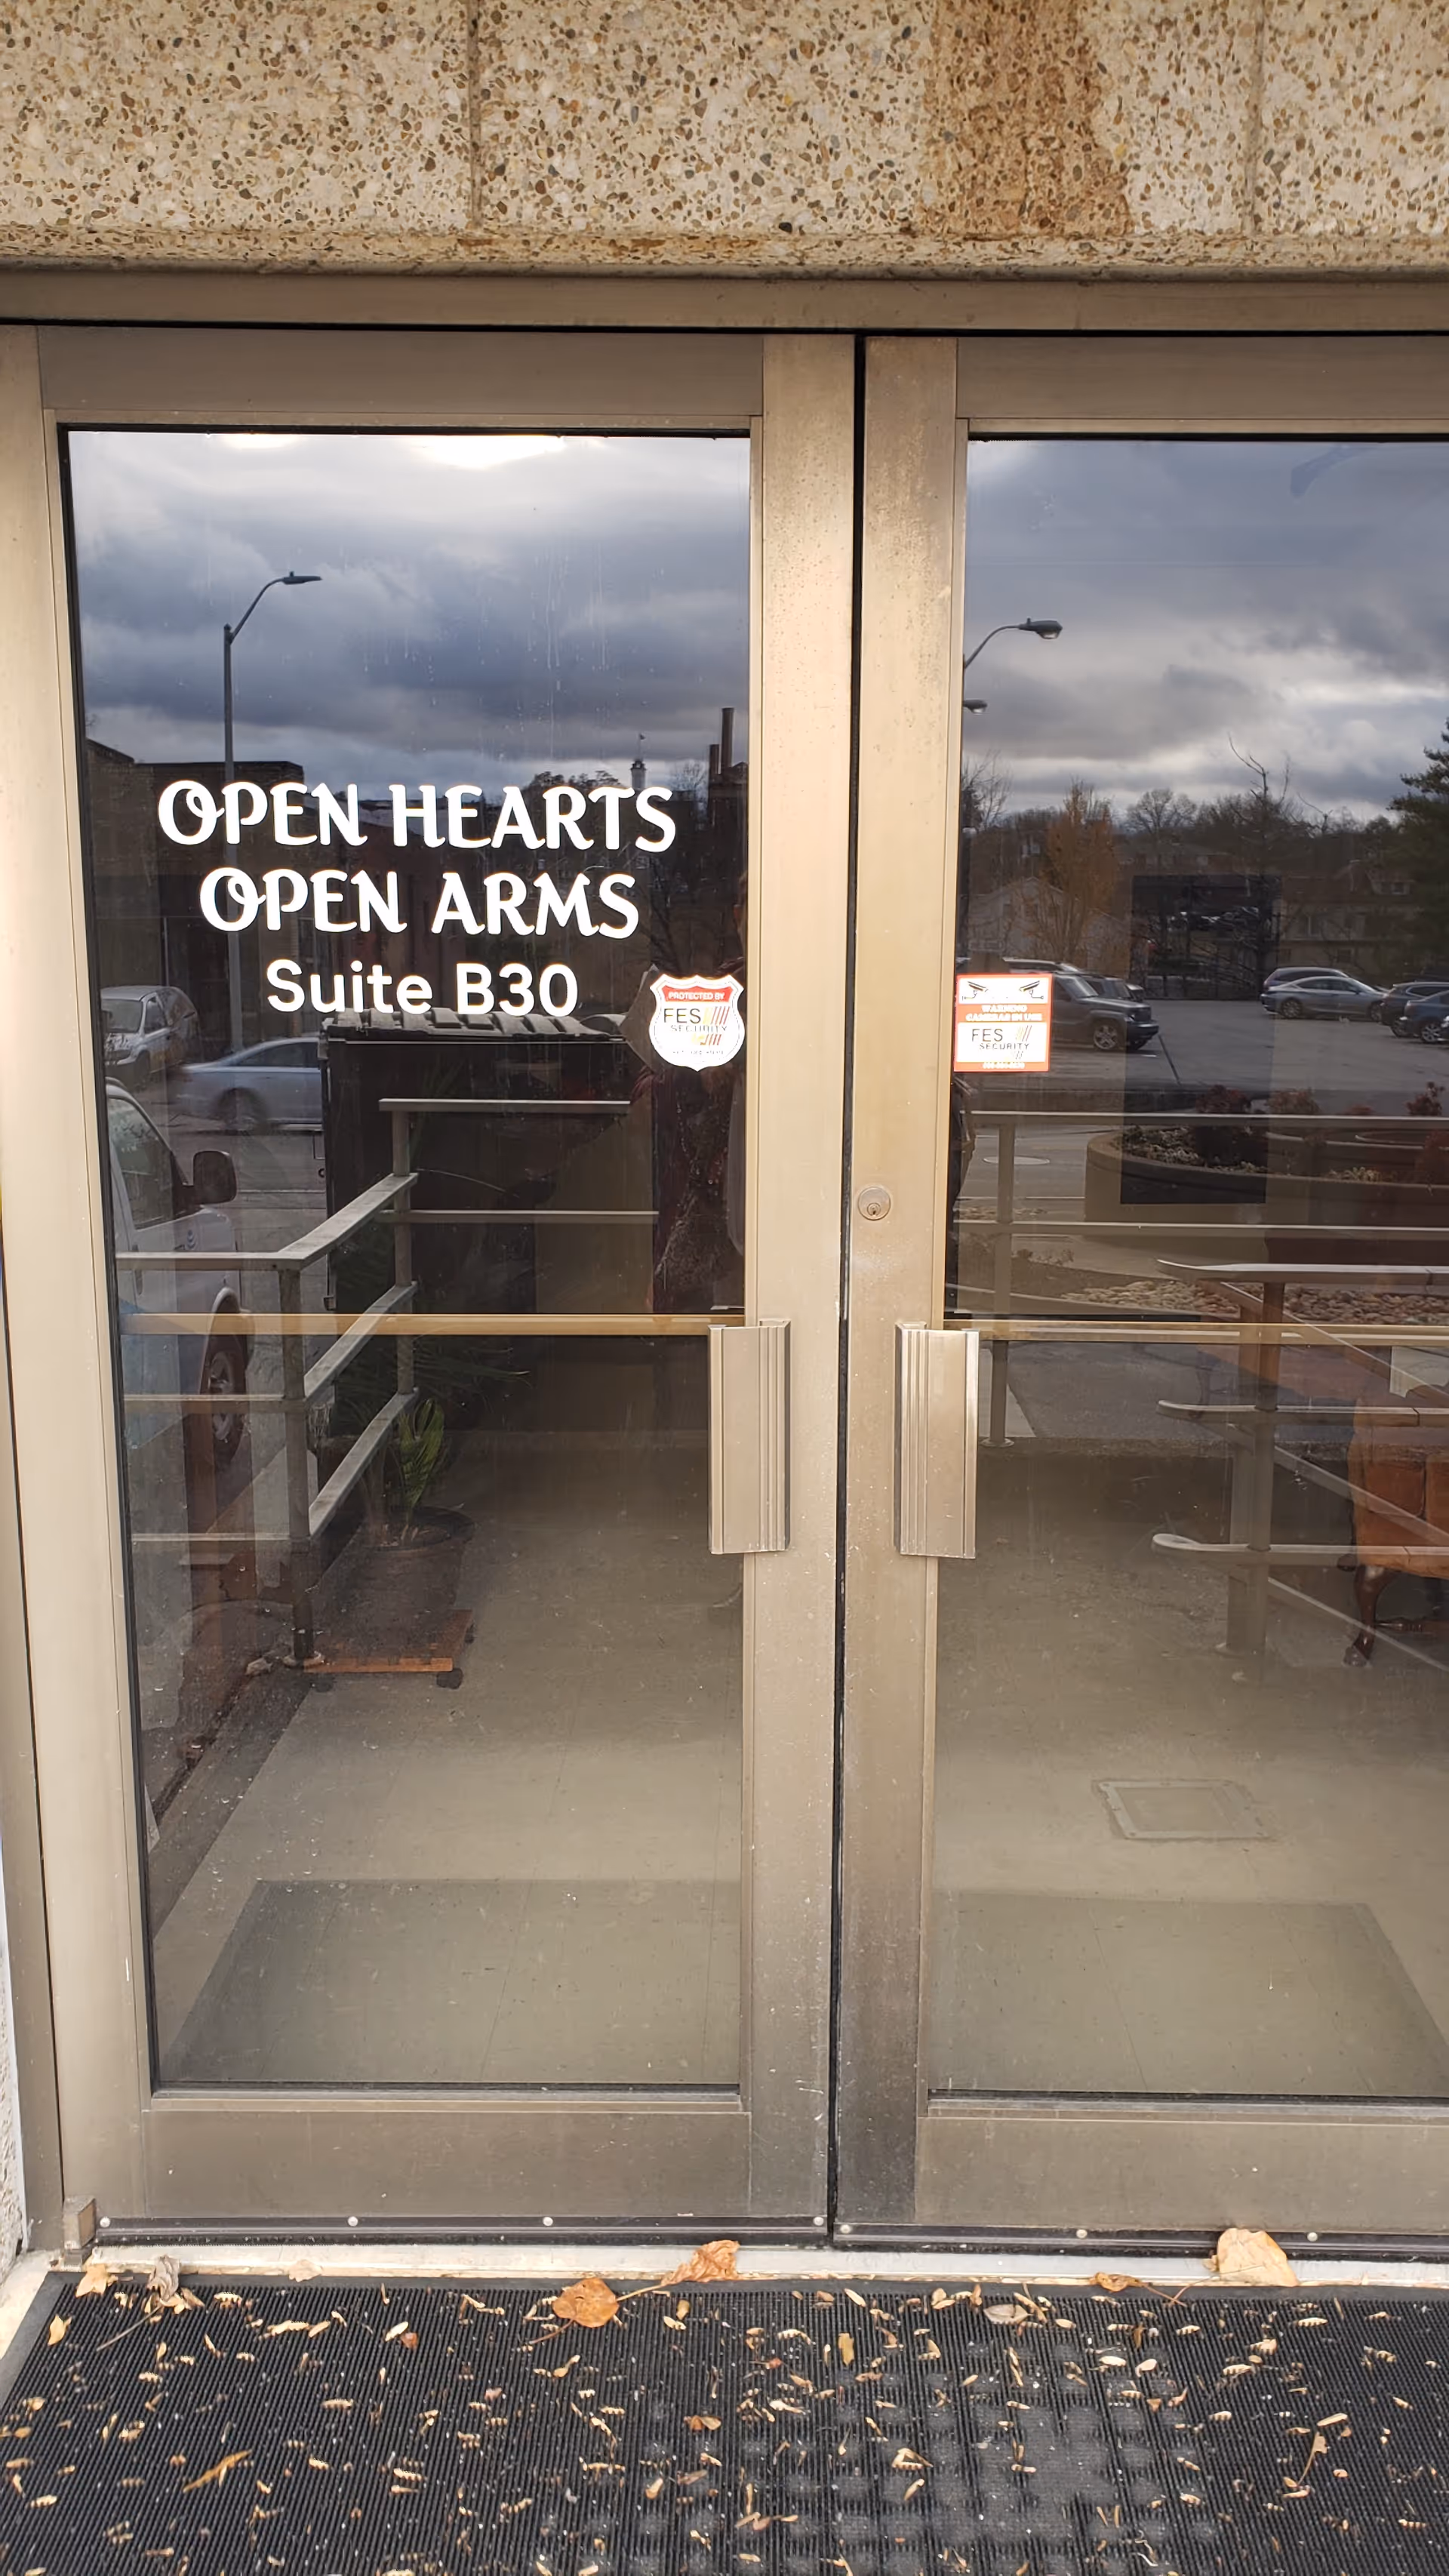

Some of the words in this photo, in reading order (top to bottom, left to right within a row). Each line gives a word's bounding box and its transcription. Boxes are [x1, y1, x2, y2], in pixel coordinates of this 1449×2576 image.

[158, 780, 368, 846] OPEN
[389, 783, 676, 852] HEARTS
[199, 867, 408, 933] OPEN
[431, 873, 639, 939] ARMS
[266, 959, 432, 1014] Suite
[456, 963, 578, 1017] B30
[669, 991, 712, 1000] PROTECTED
[714, 991, 725, 1000] BY
[663, 1008, 701, 1023] FES
[971, 1028, 1003, 1042] FES
